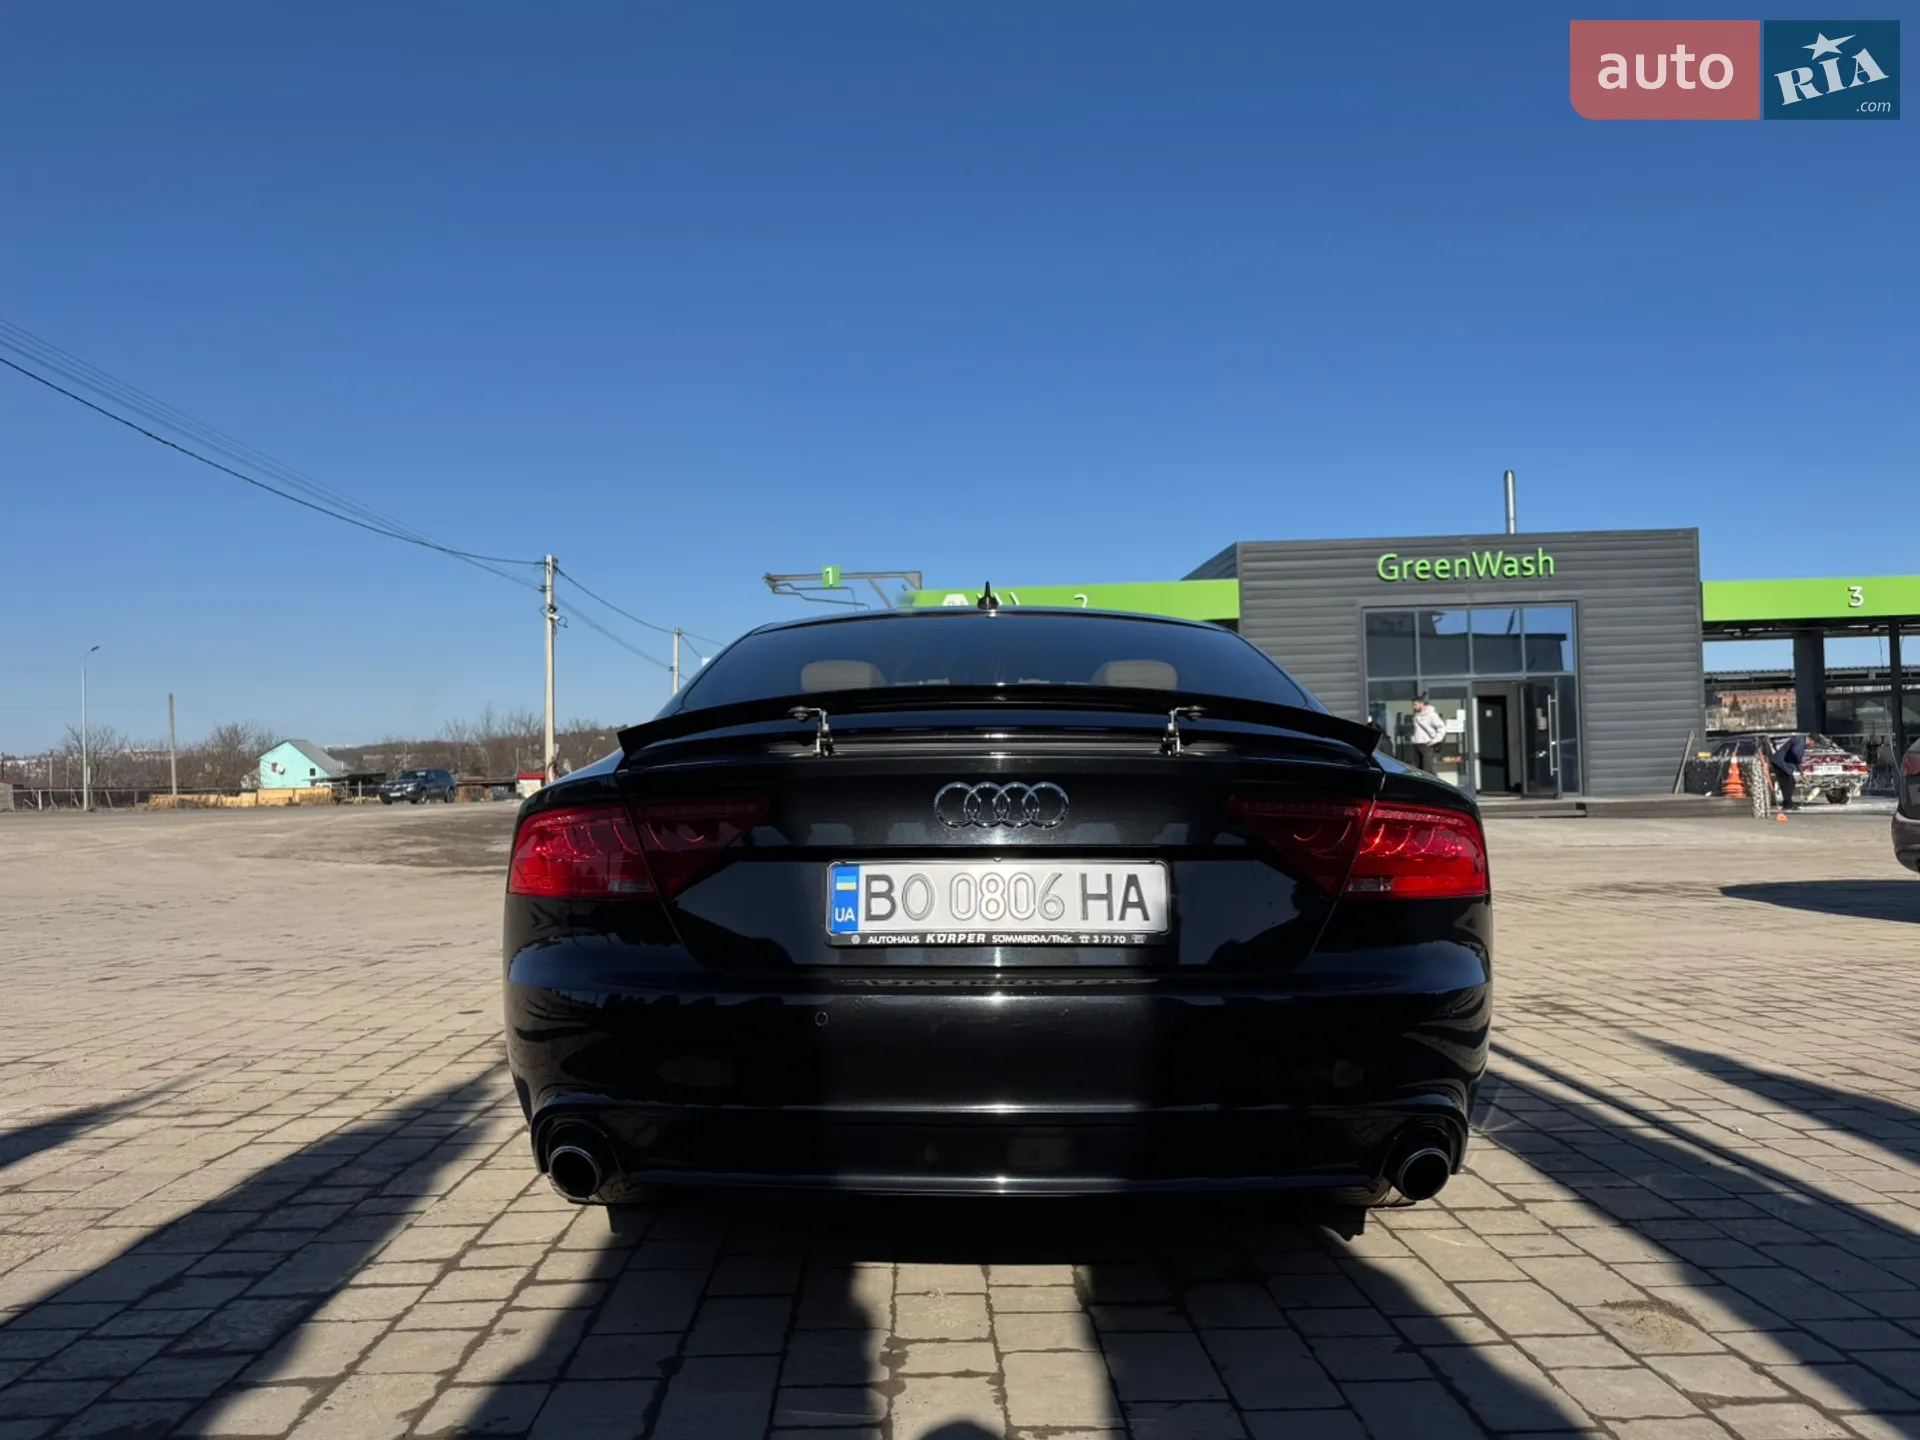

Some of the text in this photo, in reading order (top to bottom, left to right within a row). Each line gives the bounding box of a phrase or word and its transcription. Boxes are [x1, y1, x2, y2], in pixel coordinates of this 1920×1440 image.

[1377, 547, 1555, 581] GreenWash
[824, 566, 833, 585] 1
[1848, 585, 1864, 607] 3
[864, 871, 1151, 922] BO 0806 HA
[834, 907, 856, 922] UA
[867, 935, 920, 944] AUTOHAUS
[925, 933, 987, 944] KÖRPER
